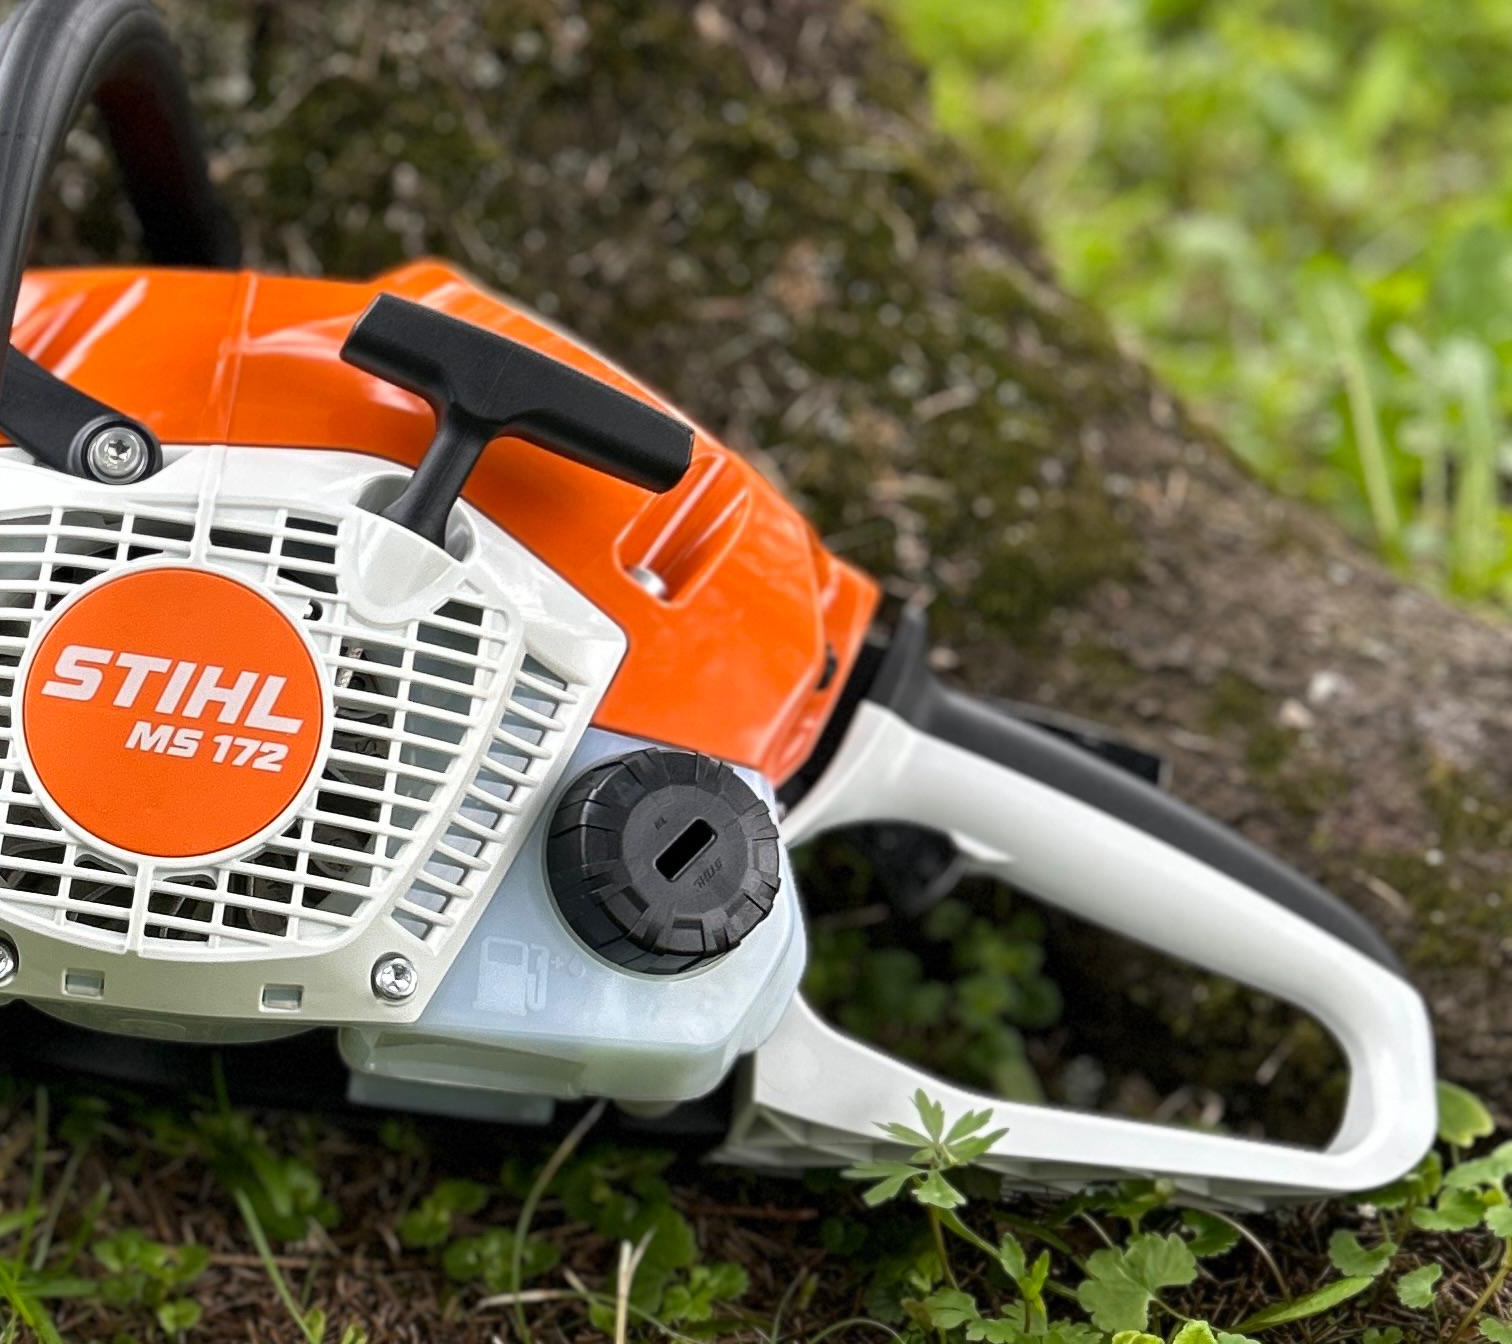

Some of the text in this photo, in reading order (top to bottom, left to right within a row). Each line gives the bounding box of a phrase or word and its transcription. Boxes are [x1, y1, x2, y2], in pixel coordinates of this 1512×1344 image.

[40, 643, 304, 735] STIHL
[124, 720, 289, 773] MS 172
